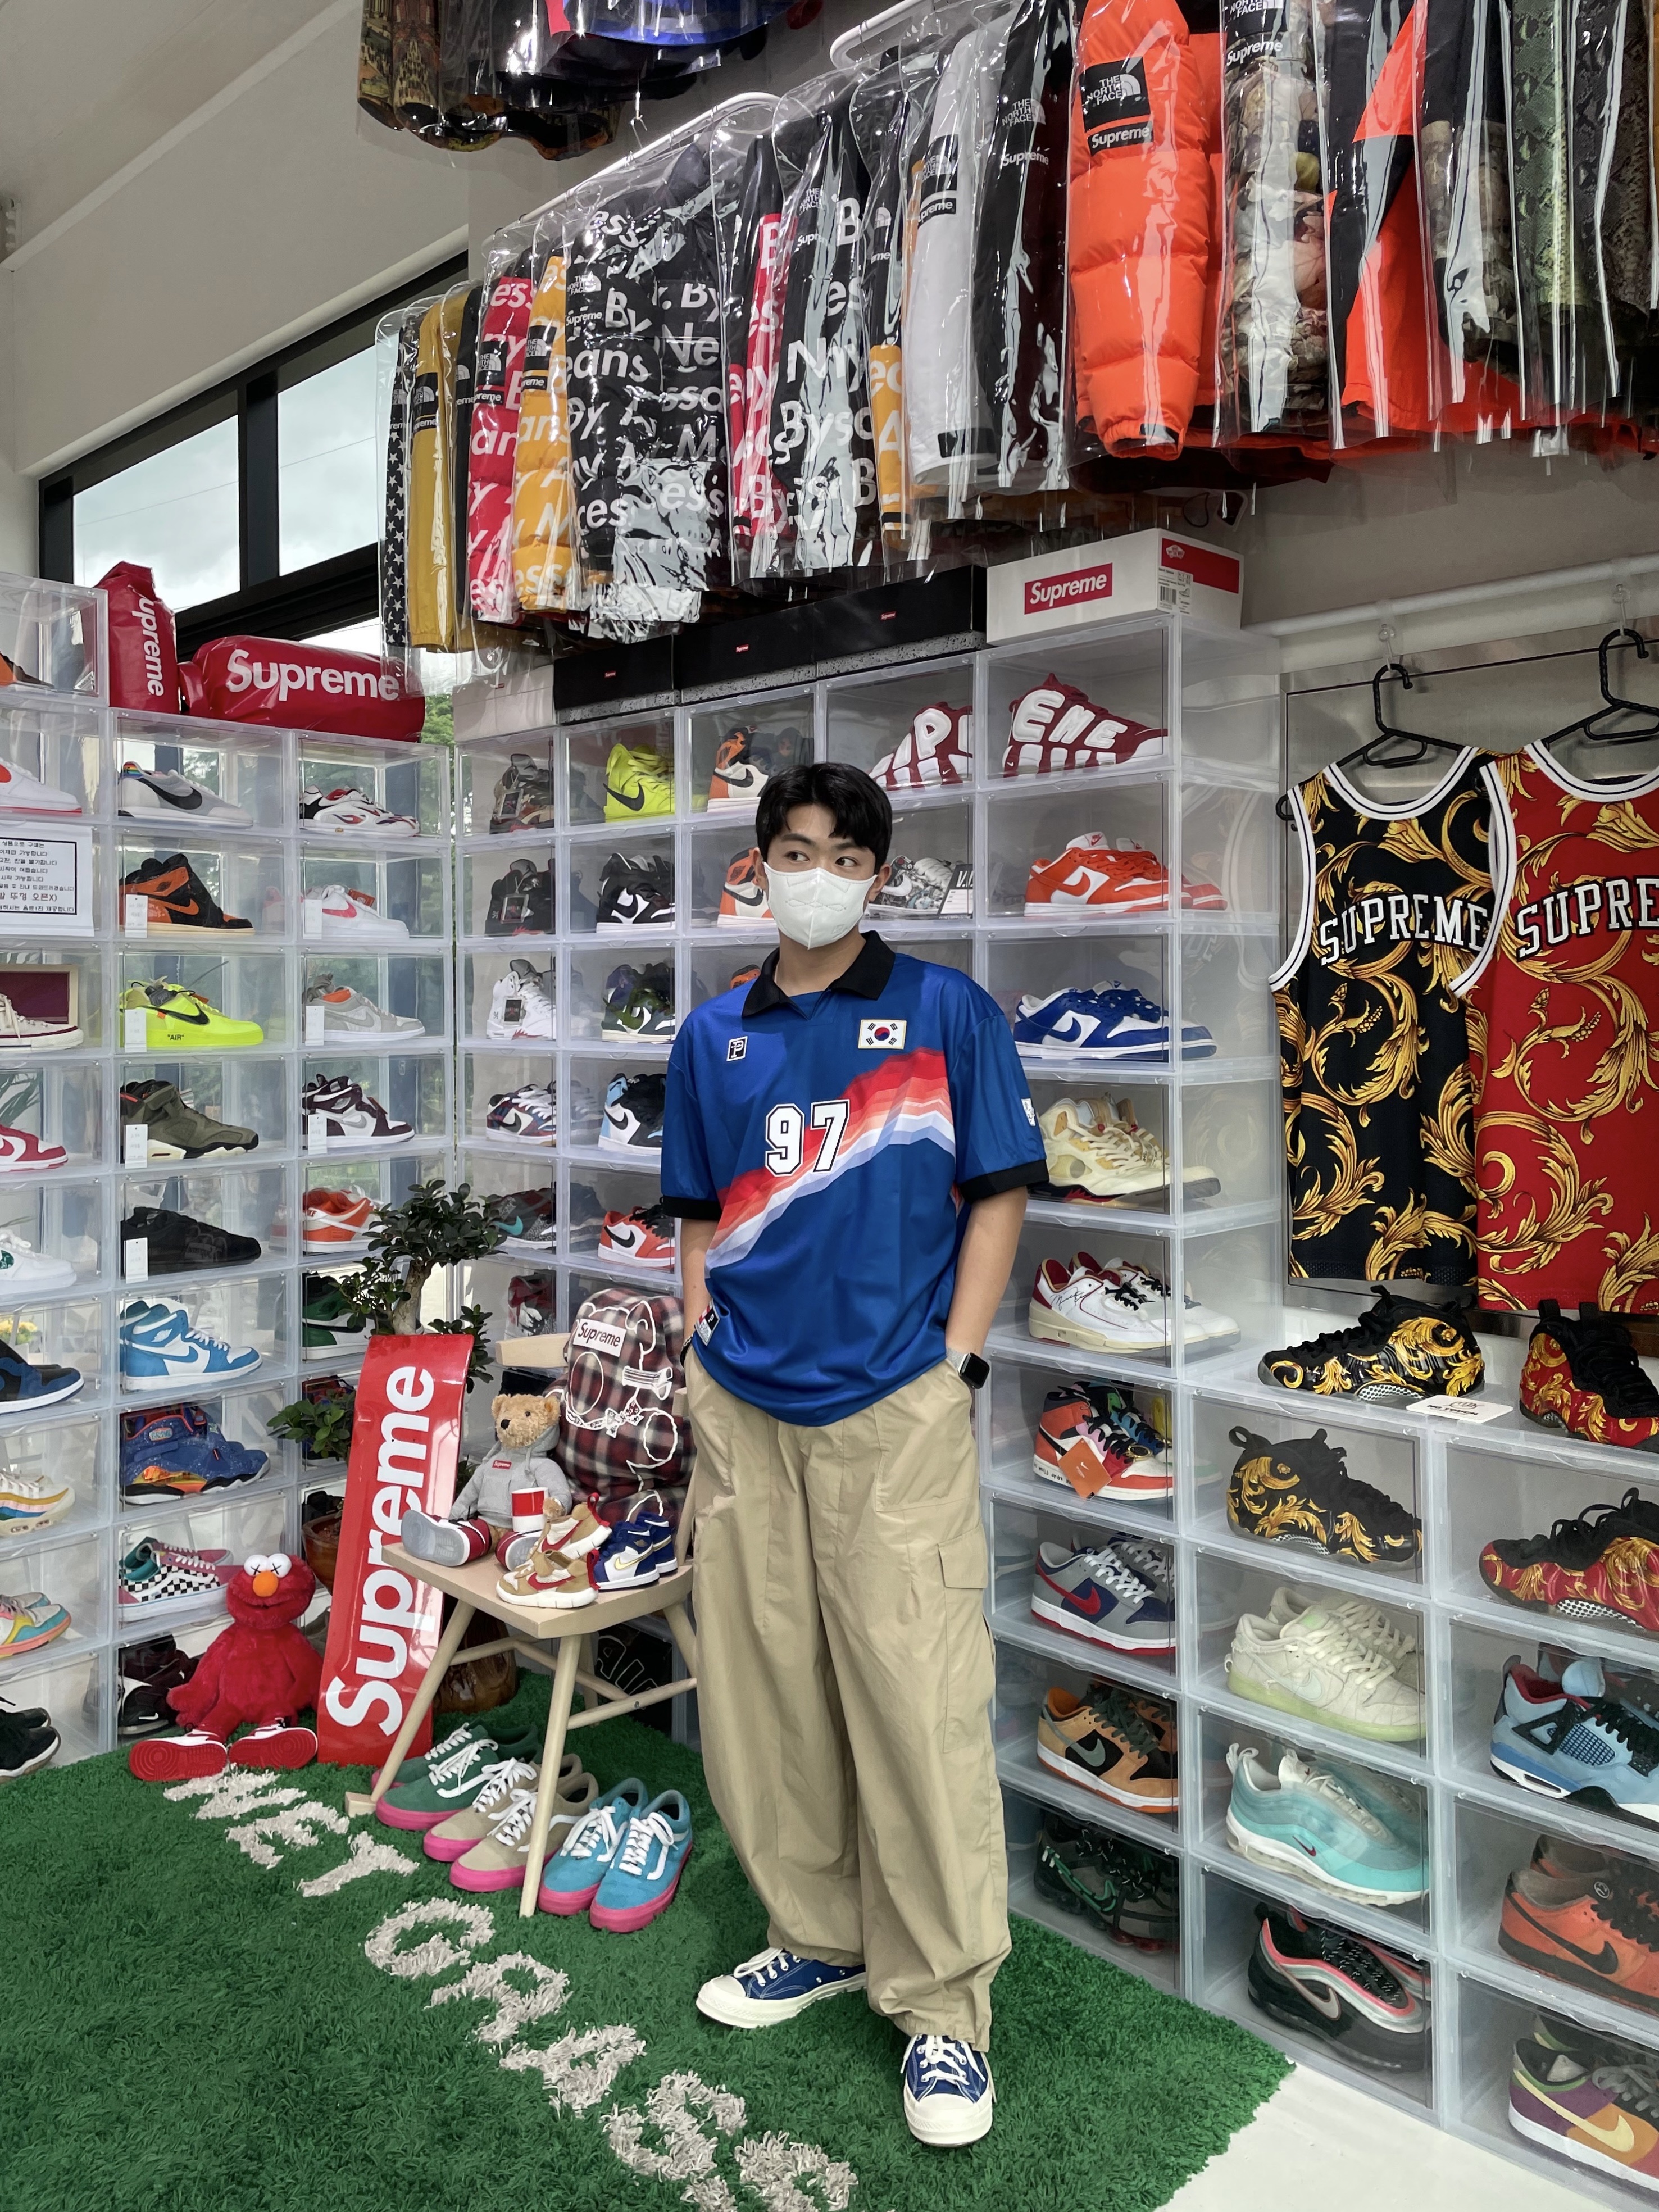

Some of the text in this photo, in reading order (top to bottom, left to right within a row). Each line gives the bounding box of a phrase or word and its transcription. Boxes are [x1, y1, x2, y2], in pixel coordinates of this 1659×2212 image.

[1237, 2, 1263, 18] FACE
[1226, 40, 1283, 66] Supreme
[1099, 74, 1120, 85] THE
[1087, 82, 1121, 103] NORTH
[1096, 90, 1122, 106] FACE
[1012, 98, 1030, 110] THE
[1002, 107, 1031, 127] NORTH
[1009, 113, 1033, 128] FACE
[1092, 126, 1150, 148] Supreme
[1002, 151, 1049, 167] Supreme
[566, 312, 603, 326] Supreme
[1030, 571, 1107, 607] Supreme
[225, 649, 401, 701] Supreme
[1320, 894, 1489, 966] SUPREME
[765, 1099, 850, 1177] 97
[578, 1321, 621, 1347] Supreme
[326, 1365, 435, 1737] Supreme
